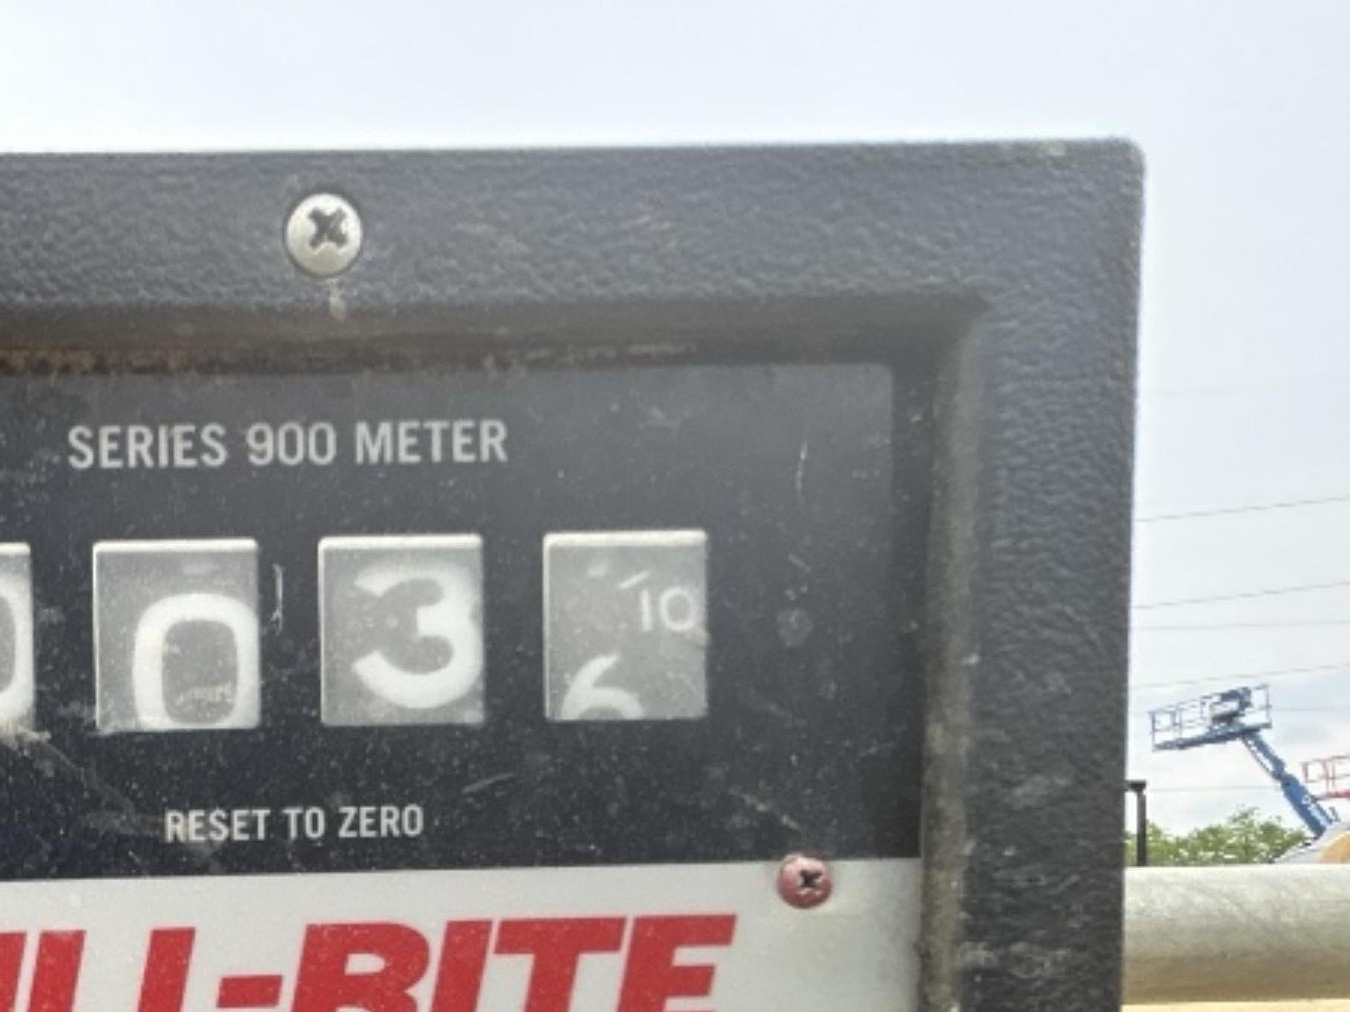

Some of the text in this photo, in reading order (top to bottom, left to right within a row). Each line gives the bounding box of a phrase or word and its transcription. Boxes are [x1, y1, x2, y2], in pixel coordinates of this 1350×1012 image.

[67, 418, 510, 470] SERIES 900 METER
[165, 803, 425, 843] RESET TO ZERO
